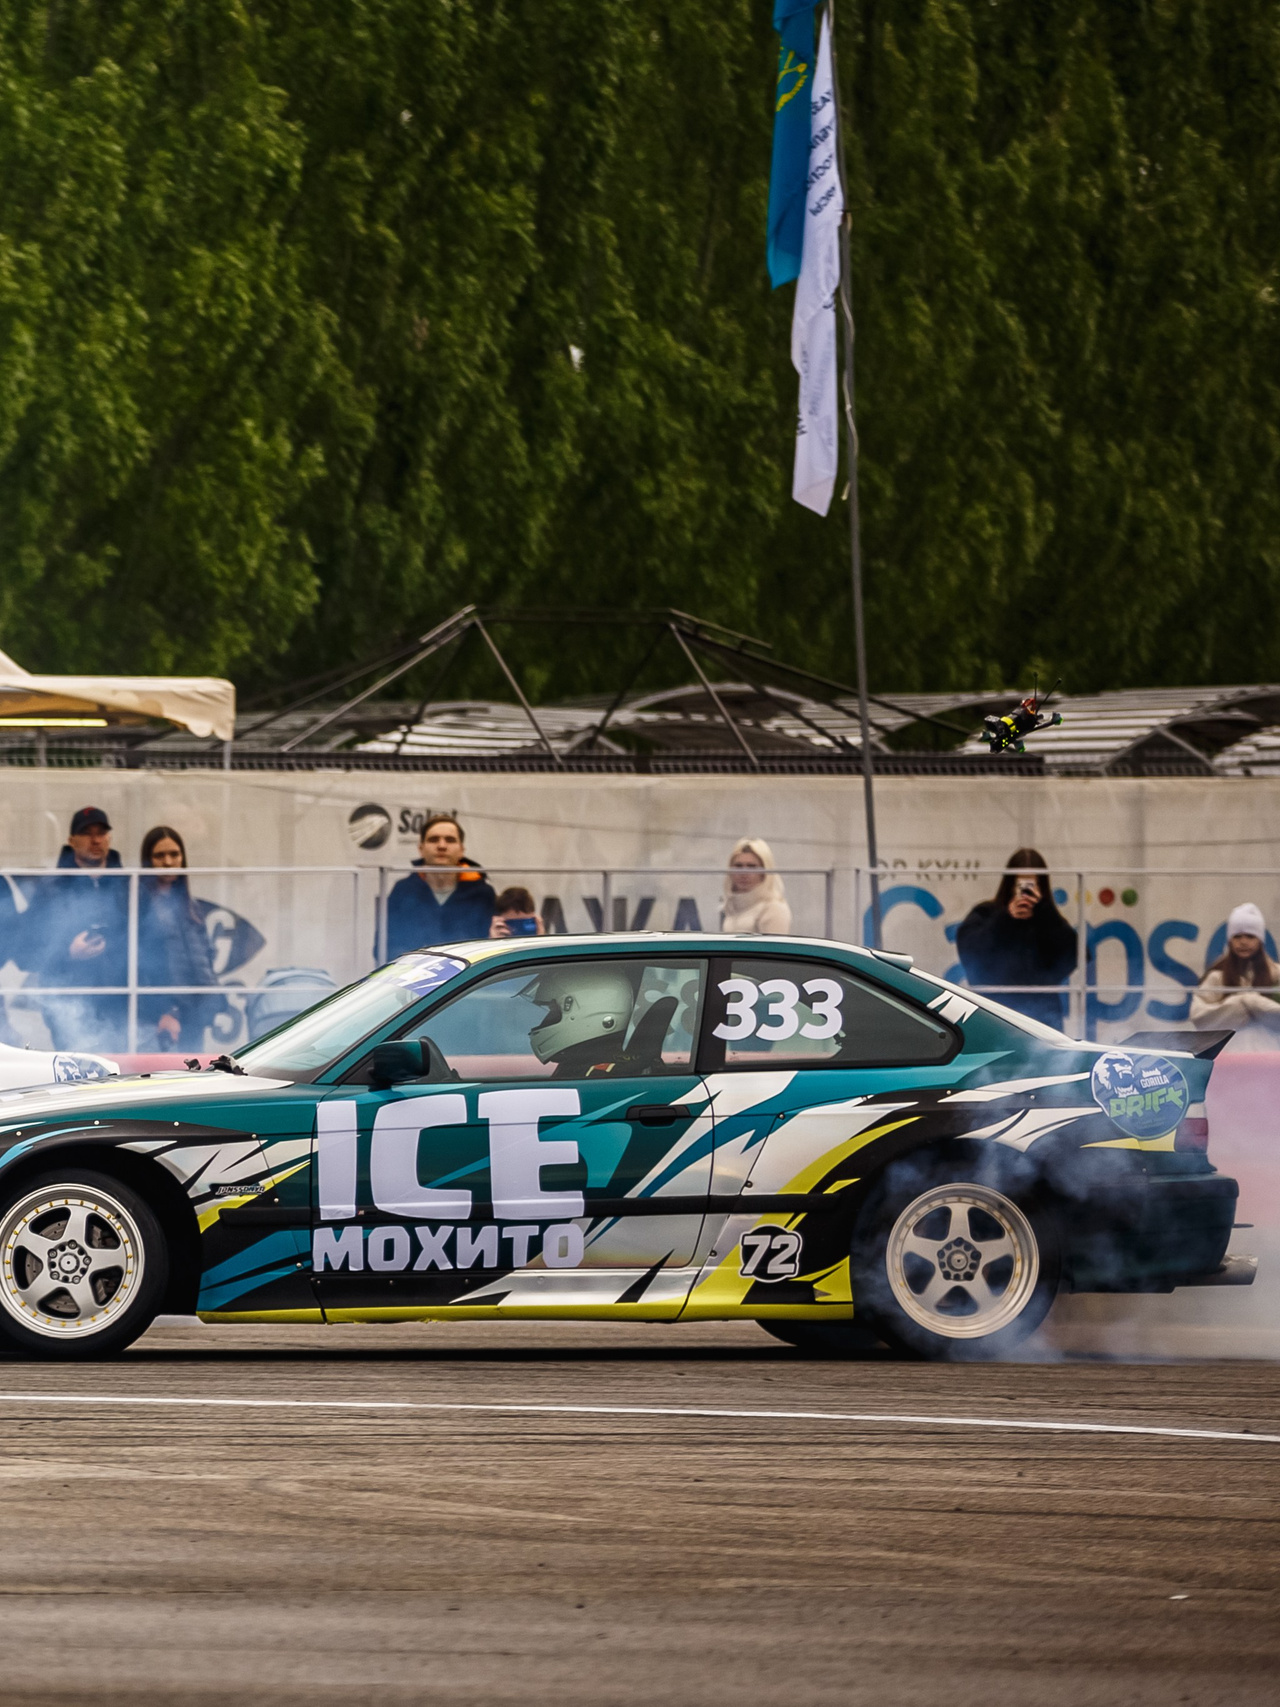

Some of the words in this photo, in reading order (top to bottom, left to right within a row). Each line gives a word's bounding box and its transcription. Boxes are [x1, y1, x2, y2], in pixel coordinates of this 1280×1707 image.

[712, 978, 844, 1041] 333
[1109, 1086, 1184, 1119] DRIFT
[1140, 1074, 1170, 1088] GORILLA
[316, 1088, 585, 1220] ICE
[313, 1223, 585, 1272] МОХИТО
[742, 1234, 799, 1274] 72
